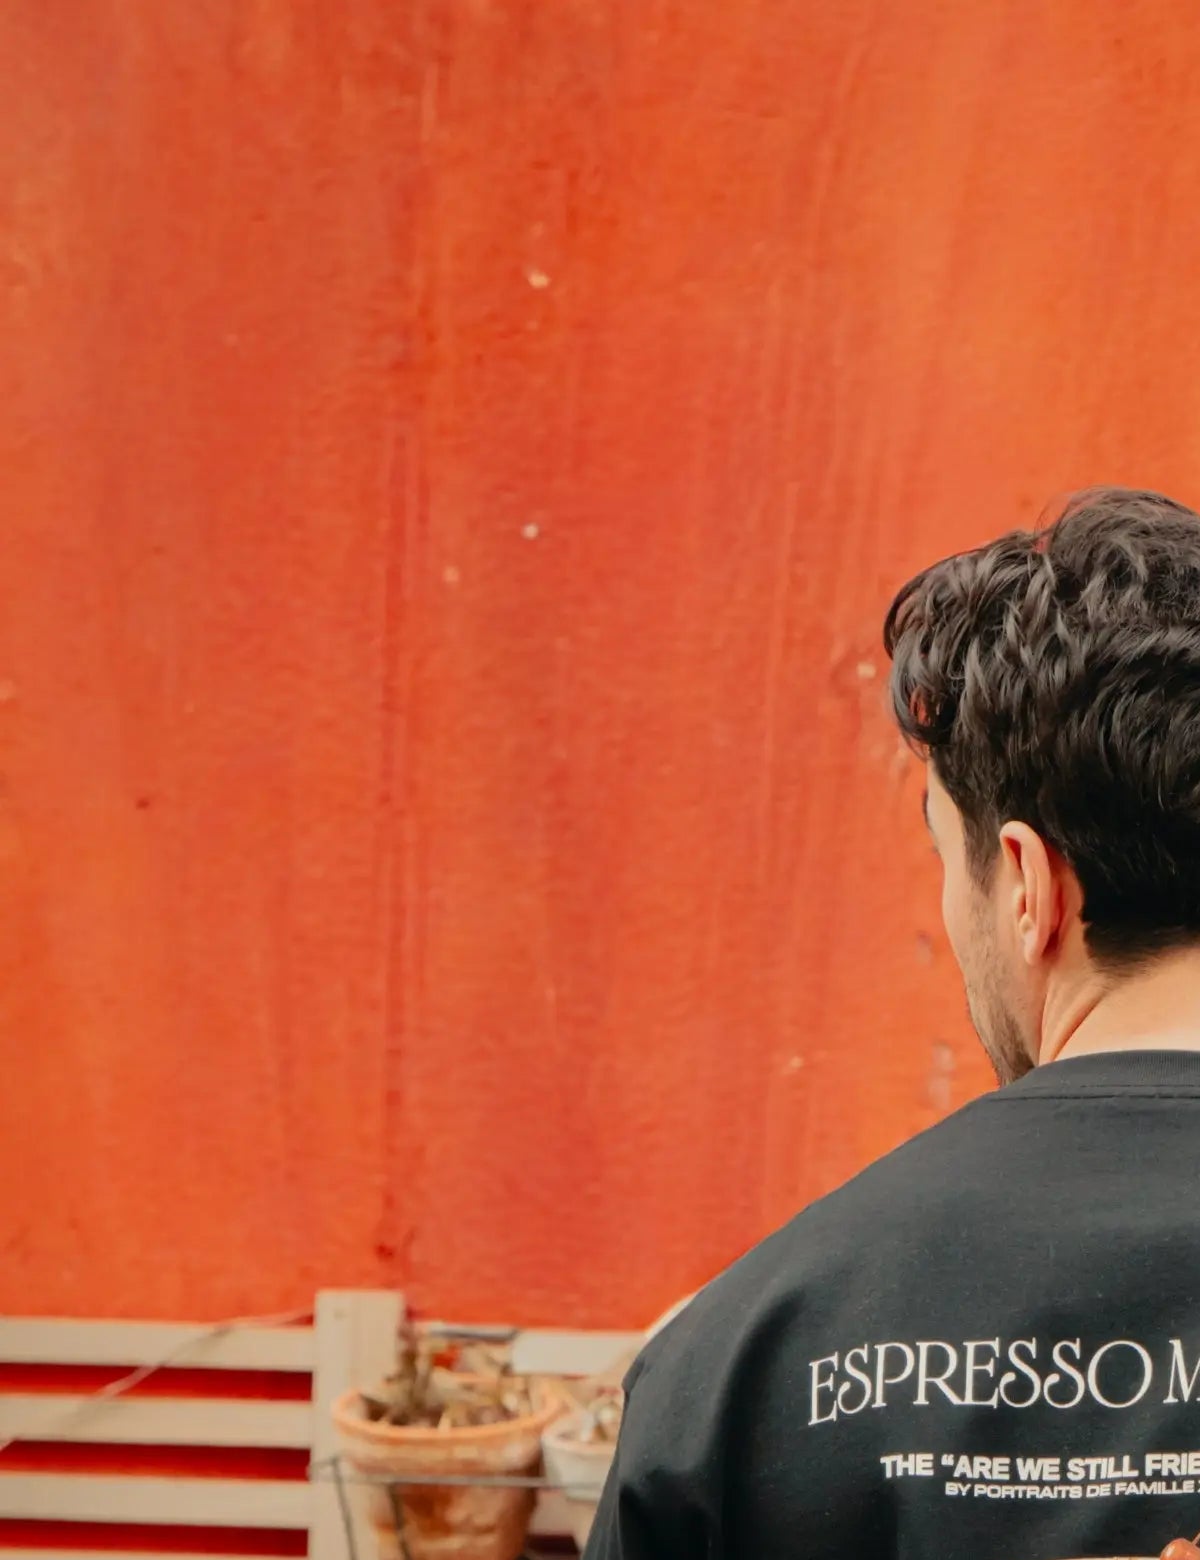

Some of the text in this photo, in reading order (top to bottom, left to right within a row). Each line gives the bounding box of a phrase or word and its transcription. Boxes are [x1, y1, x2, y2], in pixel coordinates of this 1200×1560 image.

[807, 1336, 1153, 1426] ESPRESSO
[880, 1453, 934, 1479] THE
[1016, 1457, 1061, 1481] WE
[1066, 1454, 1139, 1481] STILL
[945, 1482, 971, 1496] BY
[974, 1483, 1082, 1499] PORTRAITS
[1086, 1483, 1111, 1498] DE
[1115, 1479, 1195, 1496] FAMILLE
